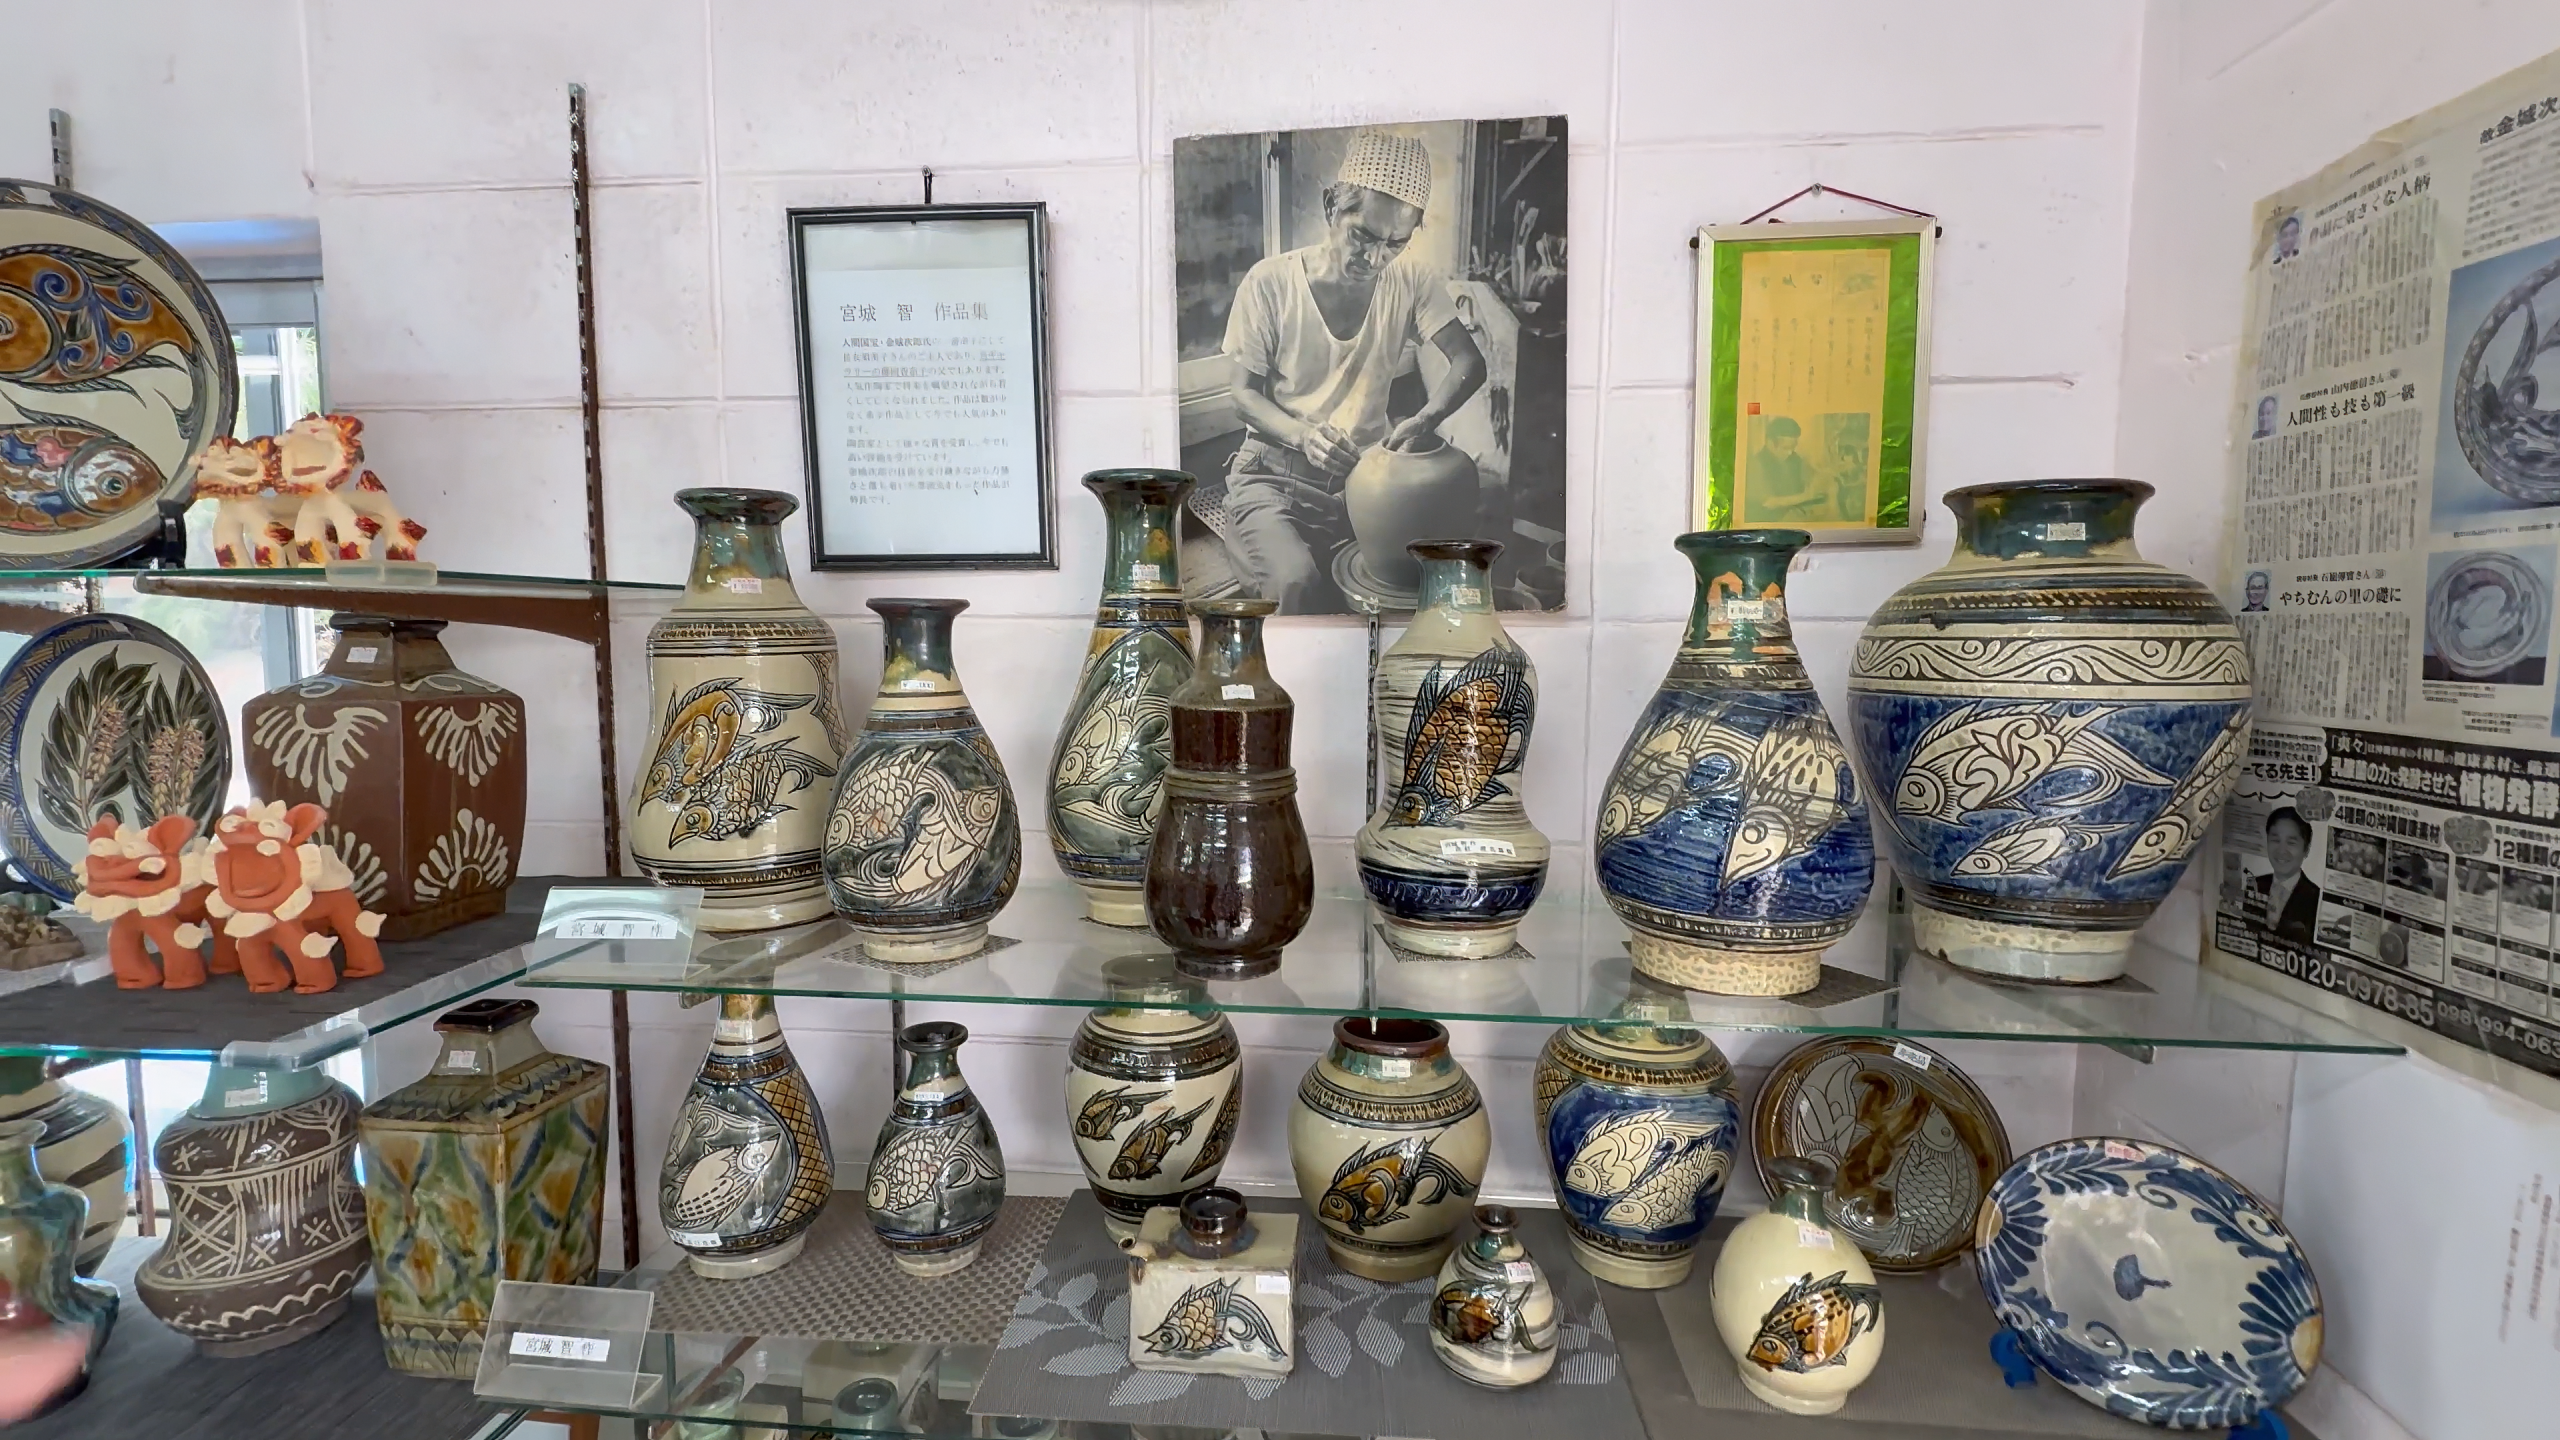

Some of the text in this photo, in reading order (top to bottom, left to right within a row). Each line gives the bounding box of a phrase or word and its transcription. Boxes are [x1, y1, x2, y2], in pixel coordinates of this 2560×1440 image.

[840, 302, 989, 322] 宮城 智 作品集
[2279, 586, 2402, 606] やちむんの里の礎に
[2285, 949, 2435, 1027] 0120-0978-85
